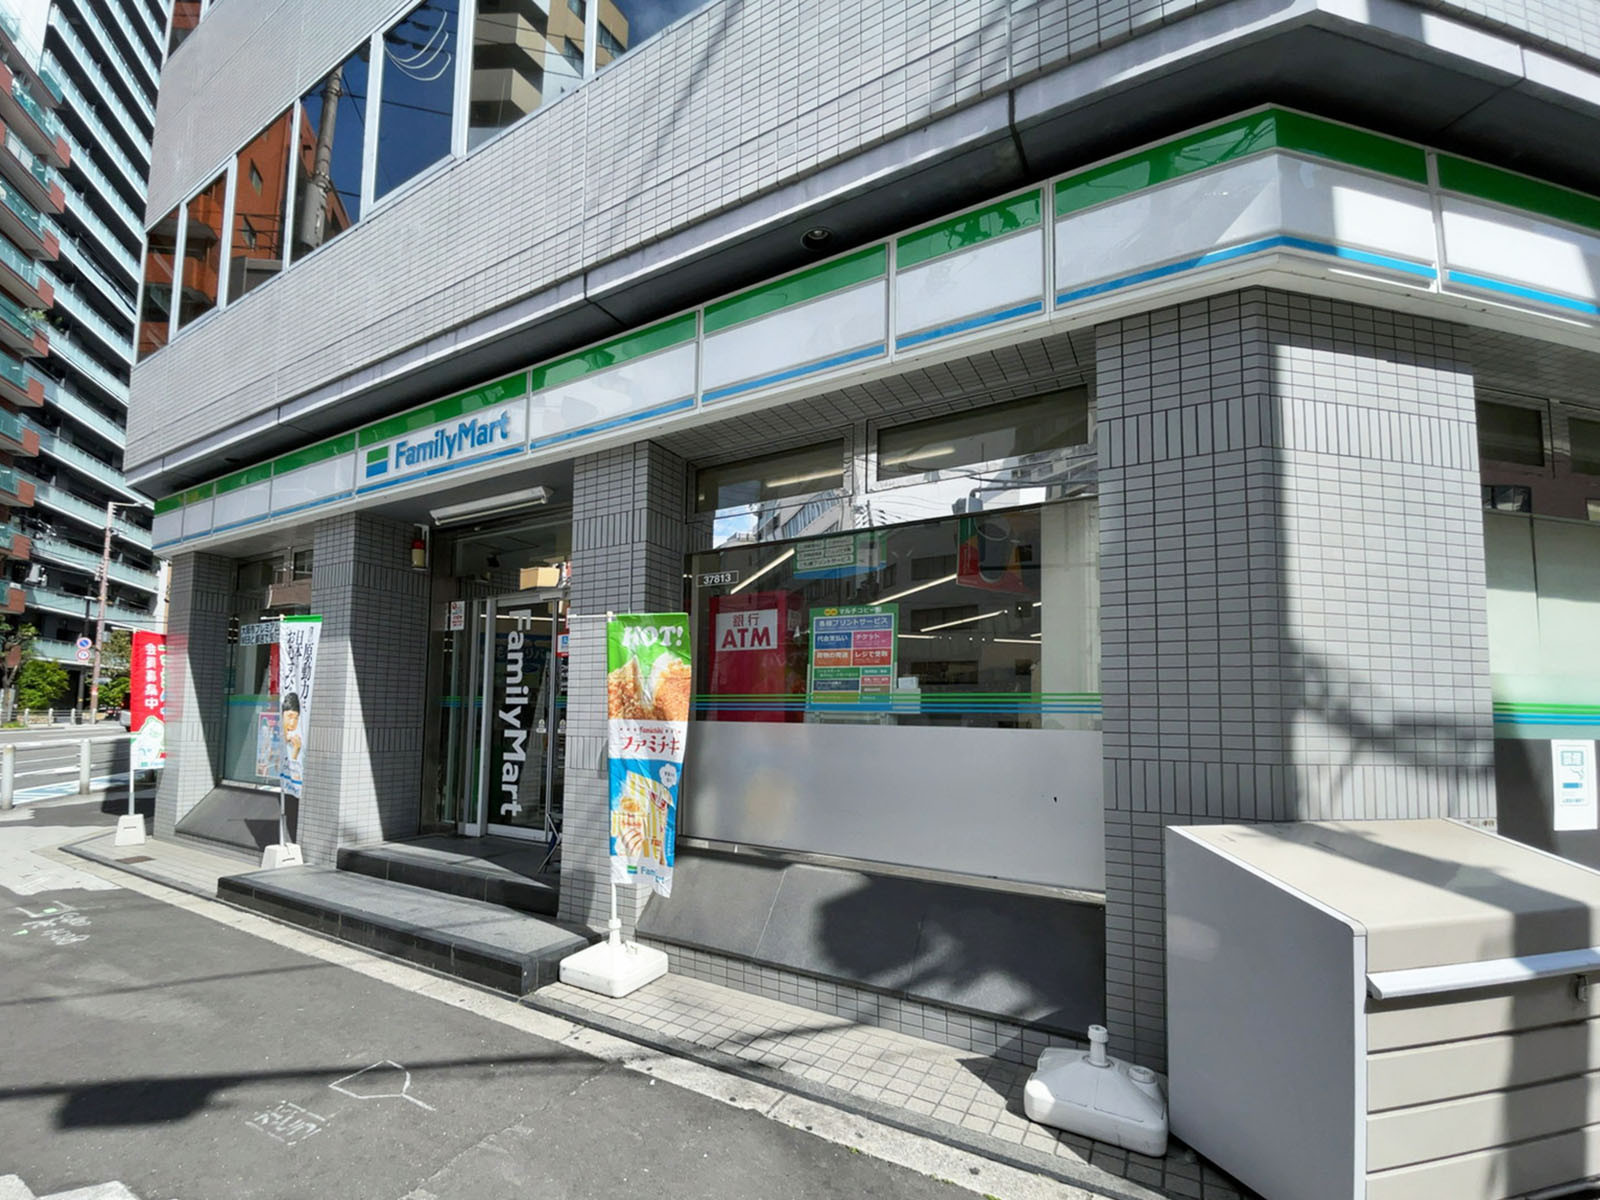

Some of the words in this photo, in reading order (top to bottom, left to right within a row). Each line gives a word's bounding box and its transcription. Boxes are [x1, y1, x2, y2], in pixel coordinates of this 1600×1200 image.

[395, 409, 511, 469] FamilyMart
[703, 573, 731, 585] 37813
[732, 612, 760, 628] 銀行
[621, 625, 684, 647] HOT!
[721, 626, 772, 649] ATM
[855, 632, 881, 641] チケット
[499, 608, 532, 817] FamilyMart
[620, 735, 681, 756] ファミチキ
